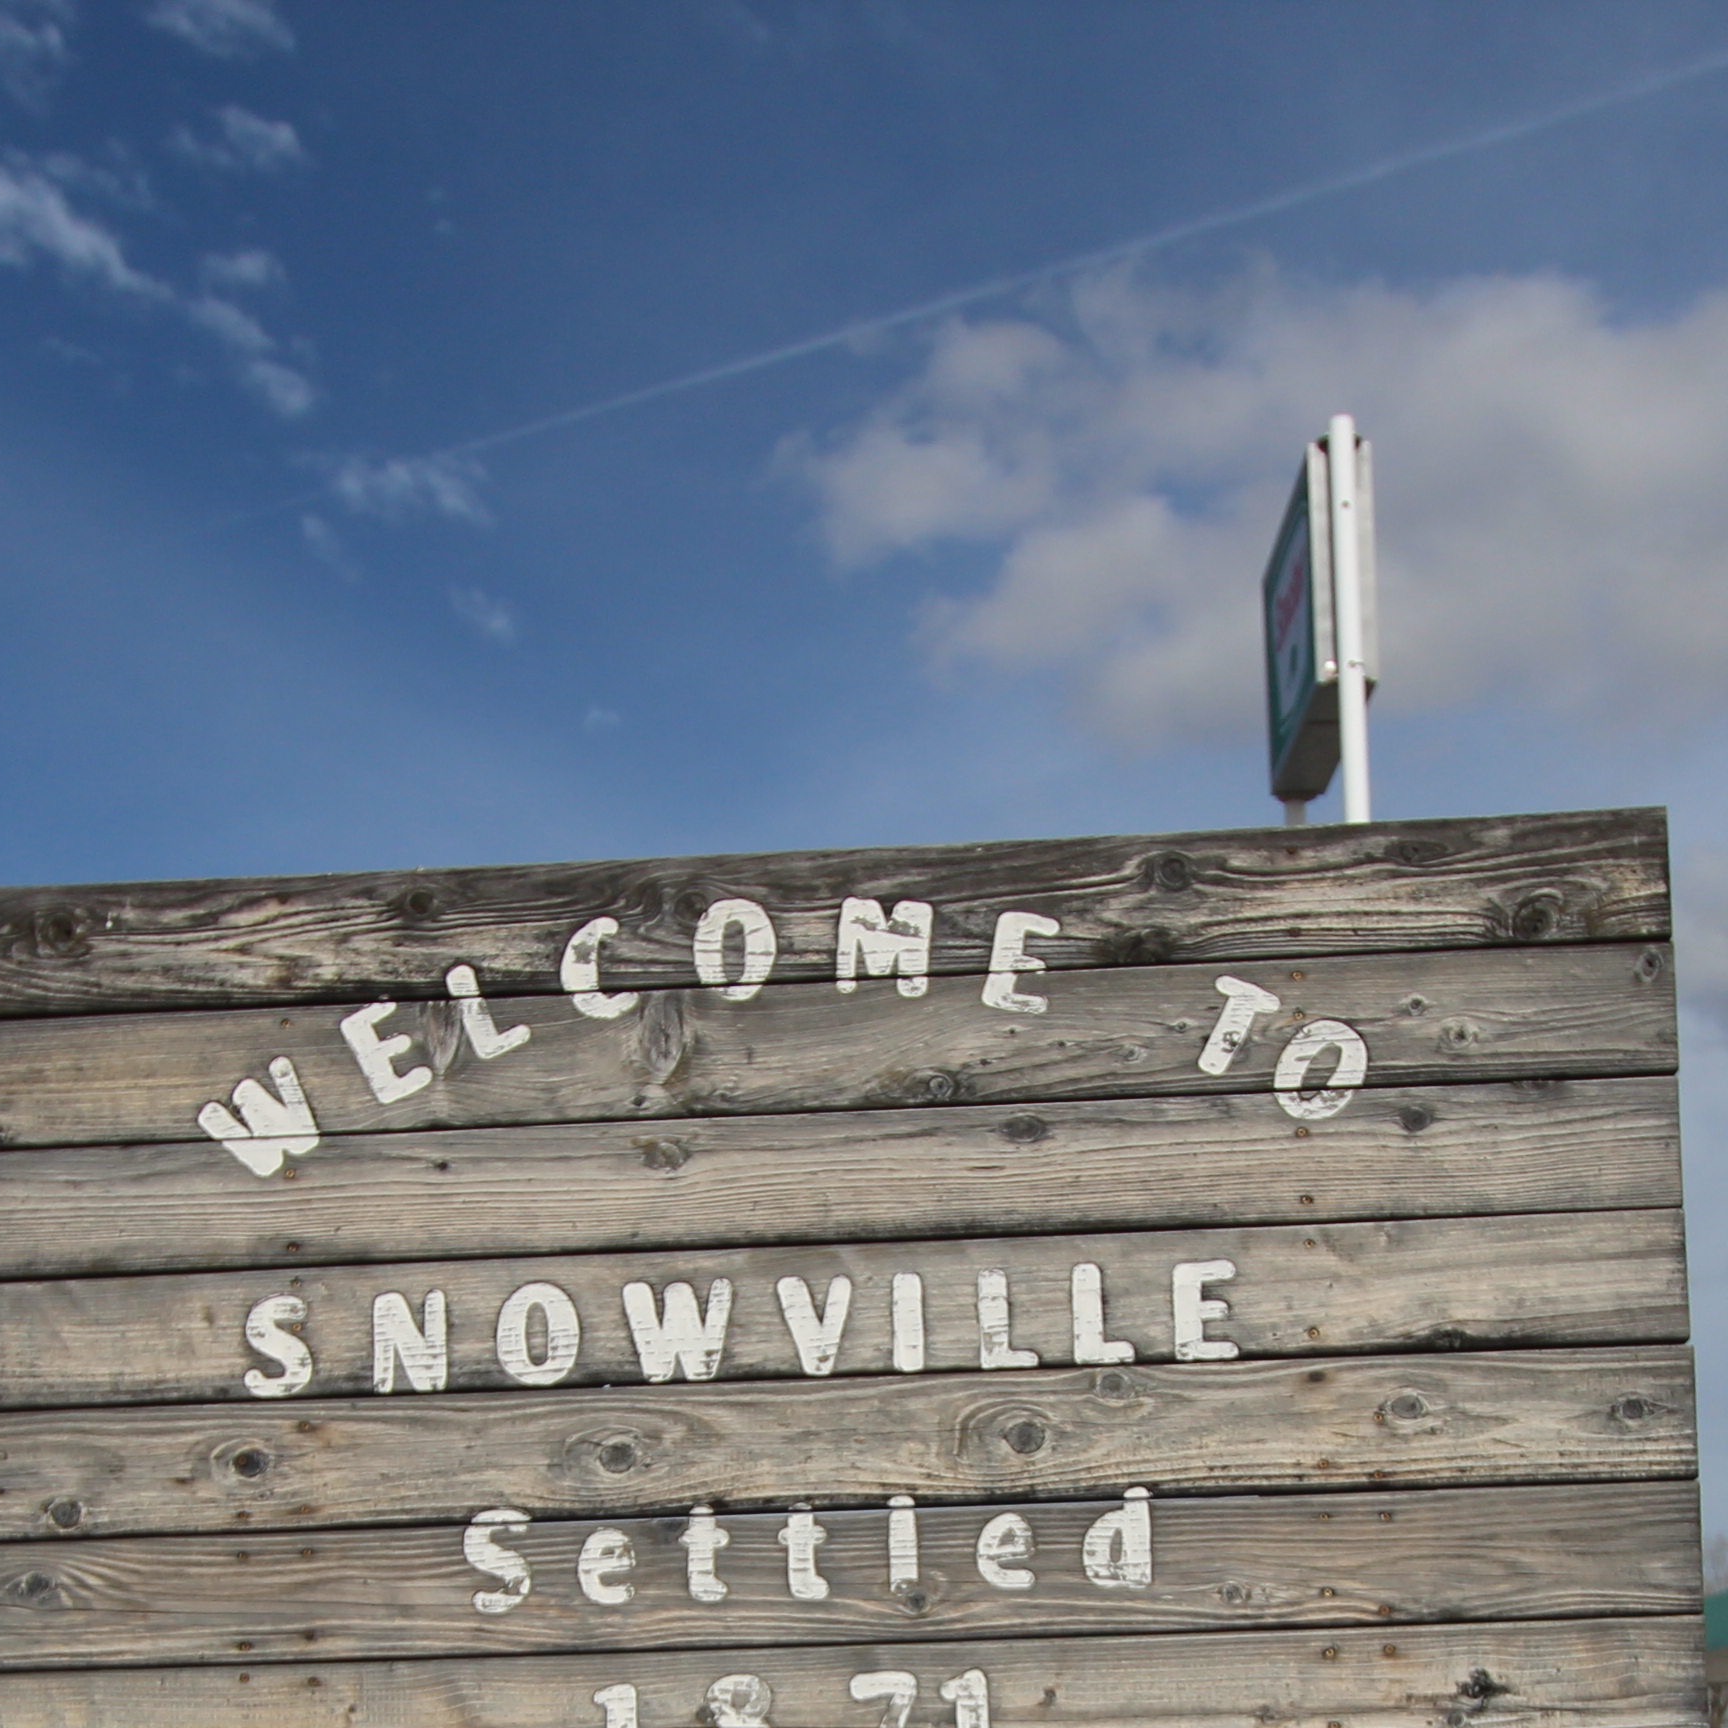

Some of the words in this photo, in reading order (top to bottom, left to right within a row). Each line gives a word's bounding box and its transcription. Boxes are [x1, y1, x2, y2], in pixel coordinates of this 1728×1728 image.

[196, 897, 1063, 1177] WELCOME
[1196, 976, 1369, 1119] TO
[243, 1259, 1240, 1397] SNOWVILLE
[463, 1487, 1153, 1613] Settled
